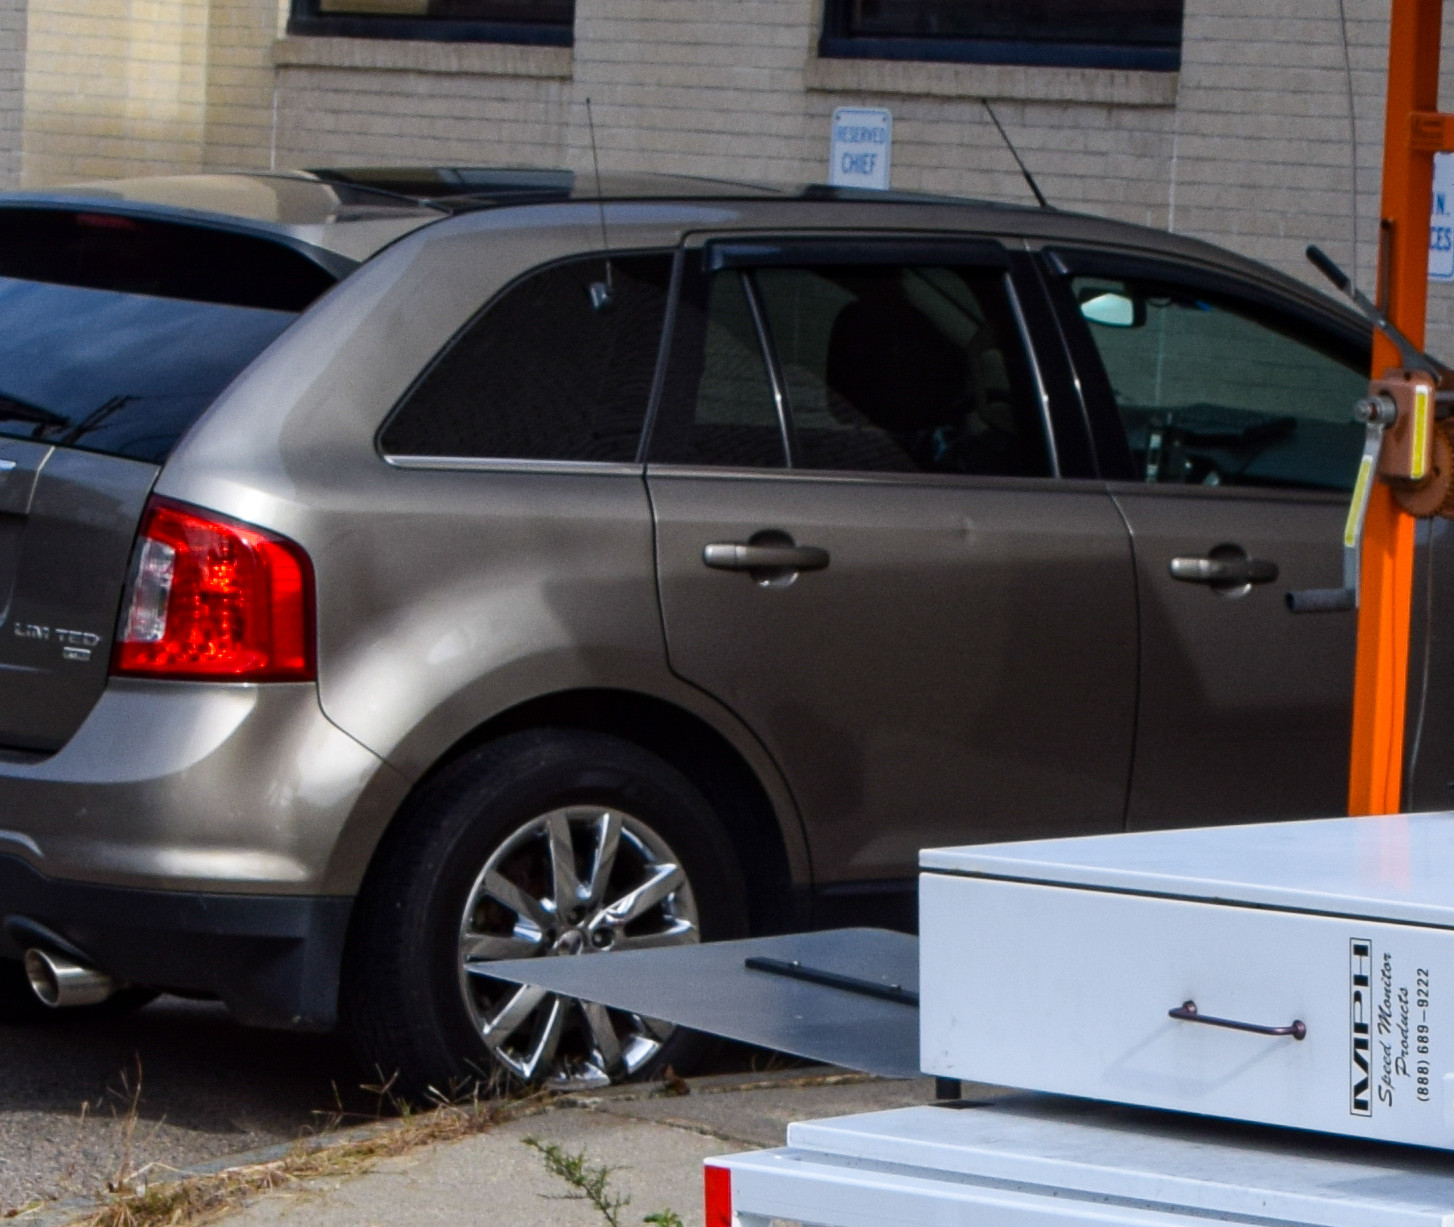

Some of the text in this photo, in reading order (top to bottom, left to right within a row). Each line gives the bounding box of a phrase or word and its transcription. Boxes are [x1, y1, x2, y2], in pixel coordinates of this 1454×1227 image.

[836, 125, 886, 143] RESERVED
[841, 152, 877, 174] CHIEF
[1353, 944, 1369, 1111] MPH
[1378, 952, 1396, 1107] Speed Monitor
[1395, 986, 1411, 1078] Products
